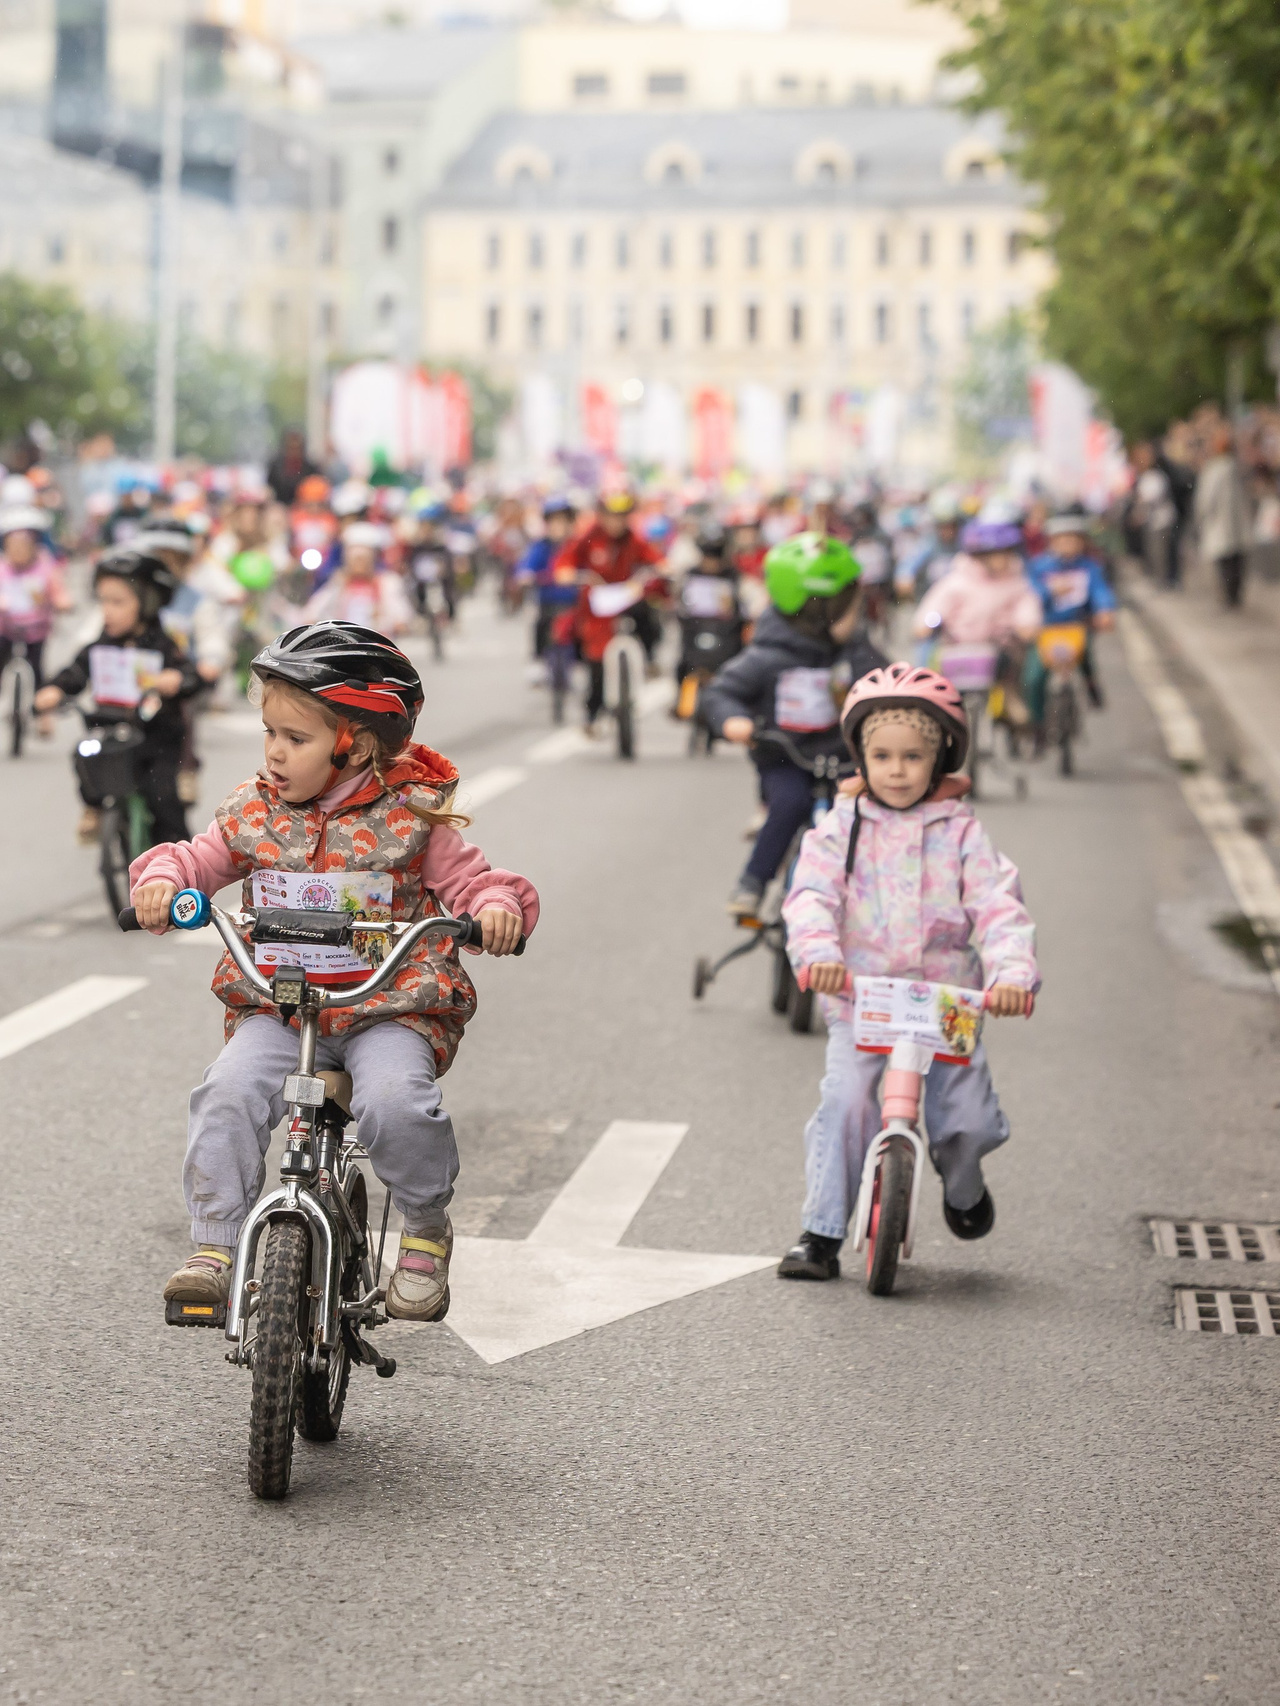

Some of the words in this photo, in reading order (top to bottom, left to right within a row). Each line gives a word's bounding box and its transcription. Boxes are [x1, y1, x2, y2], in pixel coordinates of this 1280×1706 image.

[297, 878, 337, 895] МОСКОВСКИЙ
[176, 903, 187, 920] BIKE
[183, 903, 191, 914] MY
[279, 929, 325, 939] MERIDA
